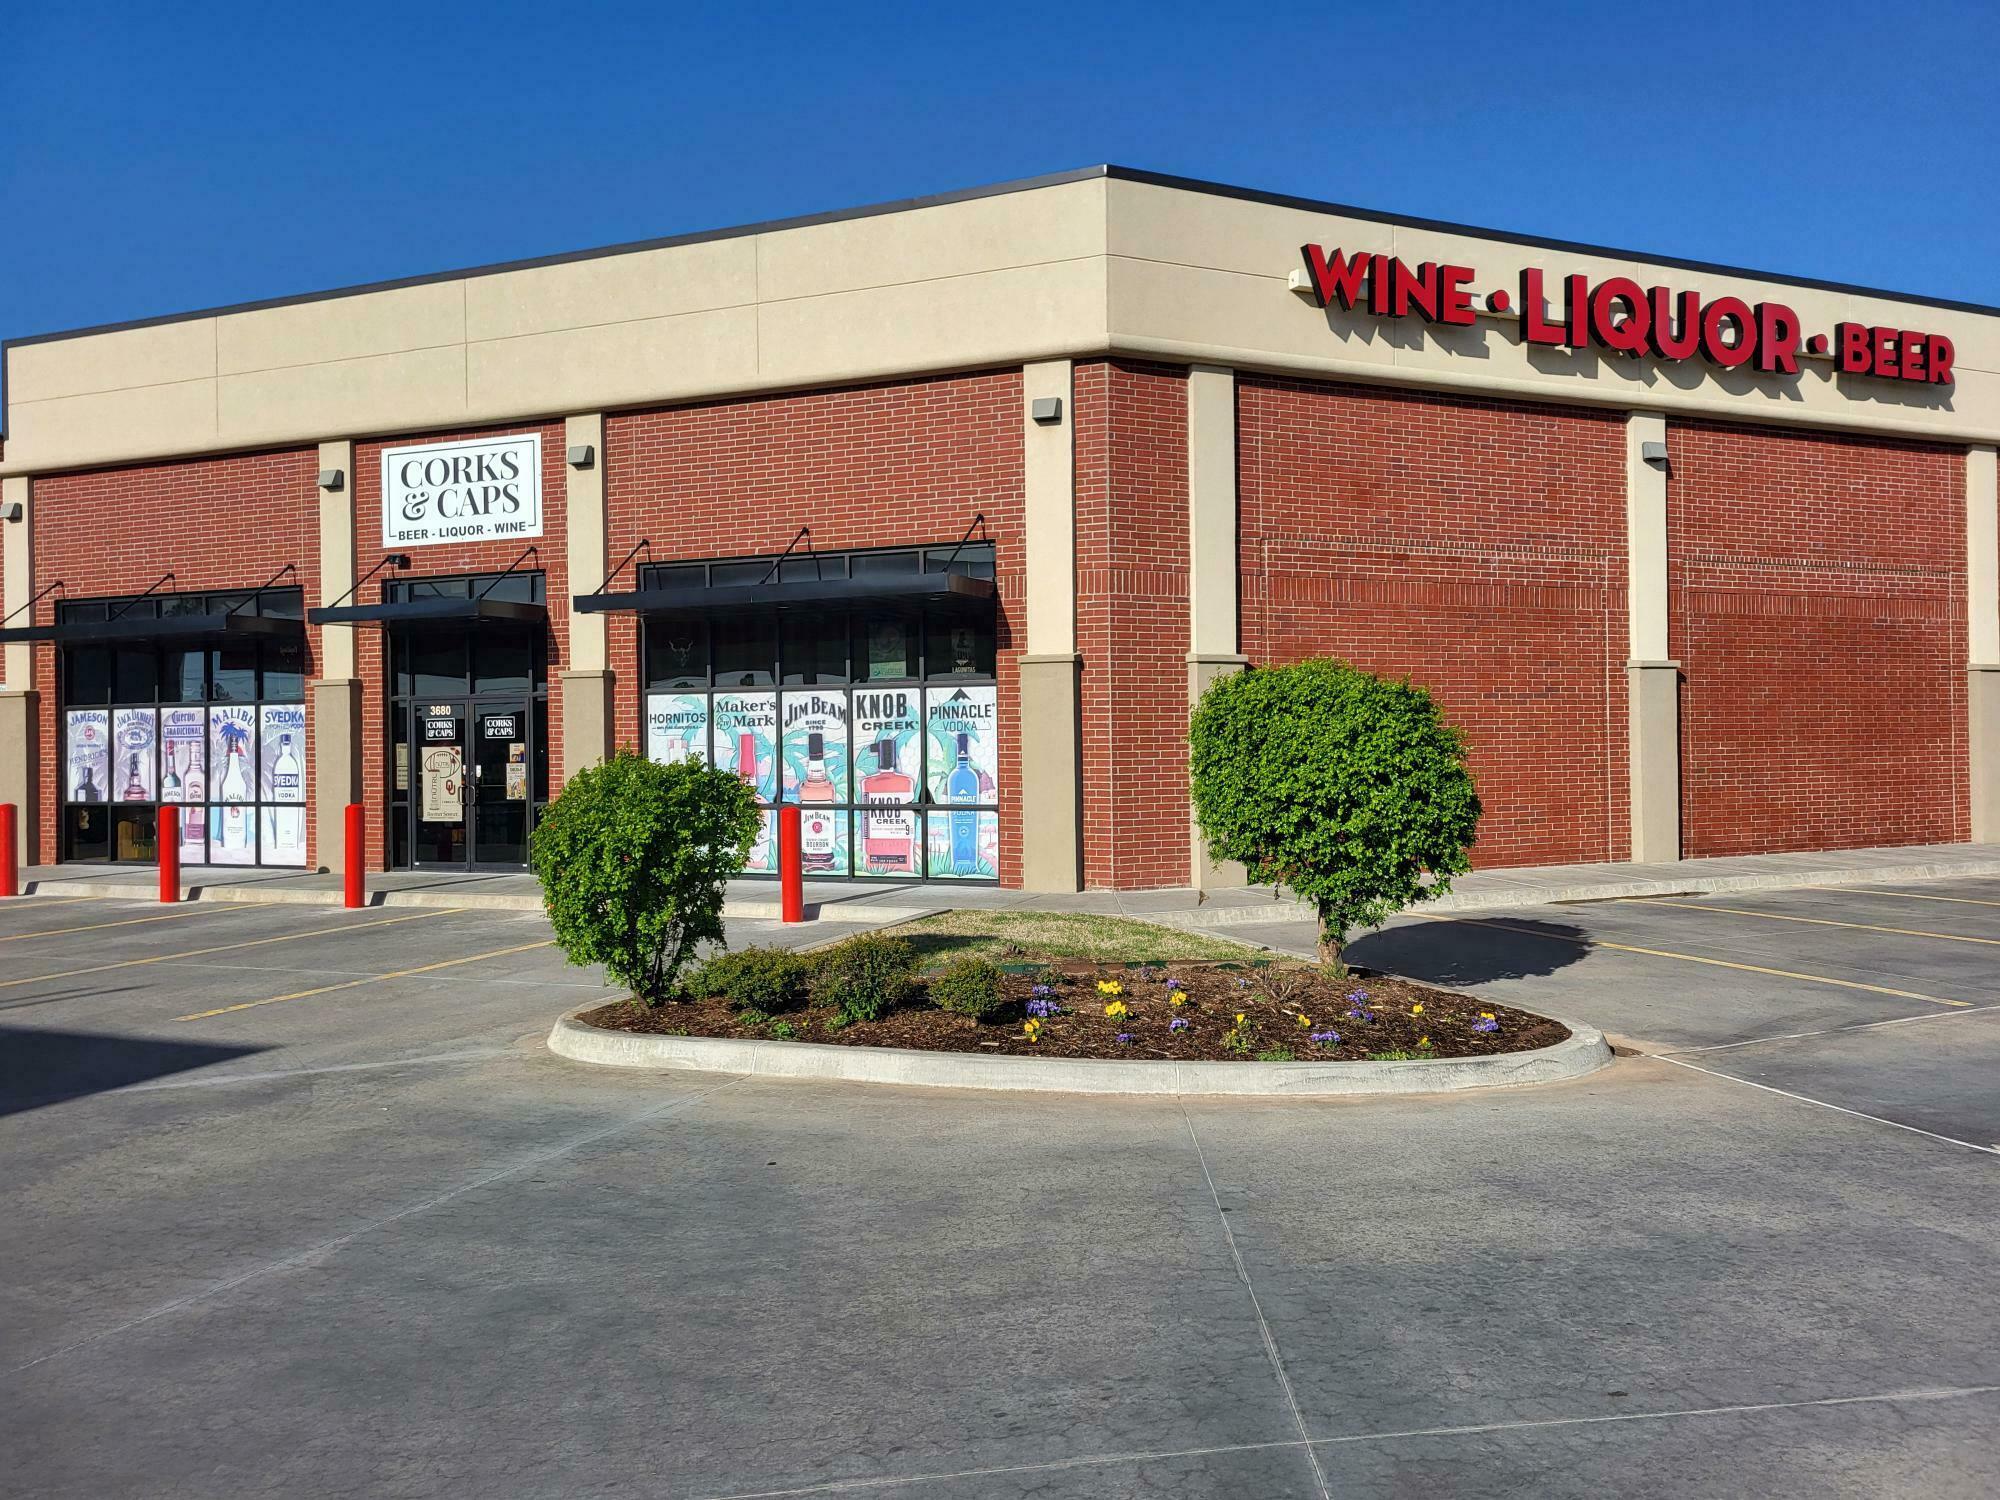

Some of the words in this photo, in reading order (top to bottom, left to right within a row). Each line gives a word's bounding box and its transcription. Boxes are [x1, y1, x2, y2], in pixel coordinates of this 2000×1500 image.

[1300, 243, 1475, 327] WINE
[1519, 267, 1800, 375] LIQUOR
[1835, 322, 1954, 385] BEER
[401, 450, 519, 489] CORKS
[402, 491, 430, 521] &
[437, 483, 520, 518] CAPS
[398, 529, 428, 540] BEER
[439, 525, 484, 538] LIQUOR
[494, 521, 527, 533] WINE
[430, 705, 451, 715] 3680
[716, 701, 776, 713] Maker's
[785, 702, 808, 728] JIM
[811, 696, 846, 724] BEAM
[856, 693, 907, 719] KNOB
[930, 704, 992, 720] PINNACLE
[71, 712, 107, 726] JAMESON
[172, 709, 195, 724] Cuervo
[212, 708, 255, 728] MALIBU
[265, 711, 305, 723] SVEDKA
[649, 713, 706, 724] HORNITOS
[733, 715, 775, 727] Mark
[428, 721, 453, 729] CORKS
[487, 719, 512, 727] CORKS
[862, 721, 915, 731] CREEK
[943, 720, 977, 732] VODKA
[166, 727, 203, 736] TRADICIONAL
[428, 729, 435, 738] &
[435, 729, 453, 737] CAPS
[487, 728, 494, 736] &
[494, 727, 513, 736] CAPS
[804, 814, 814, 824] JIM
[815, 812, 830, 822] BEAM
